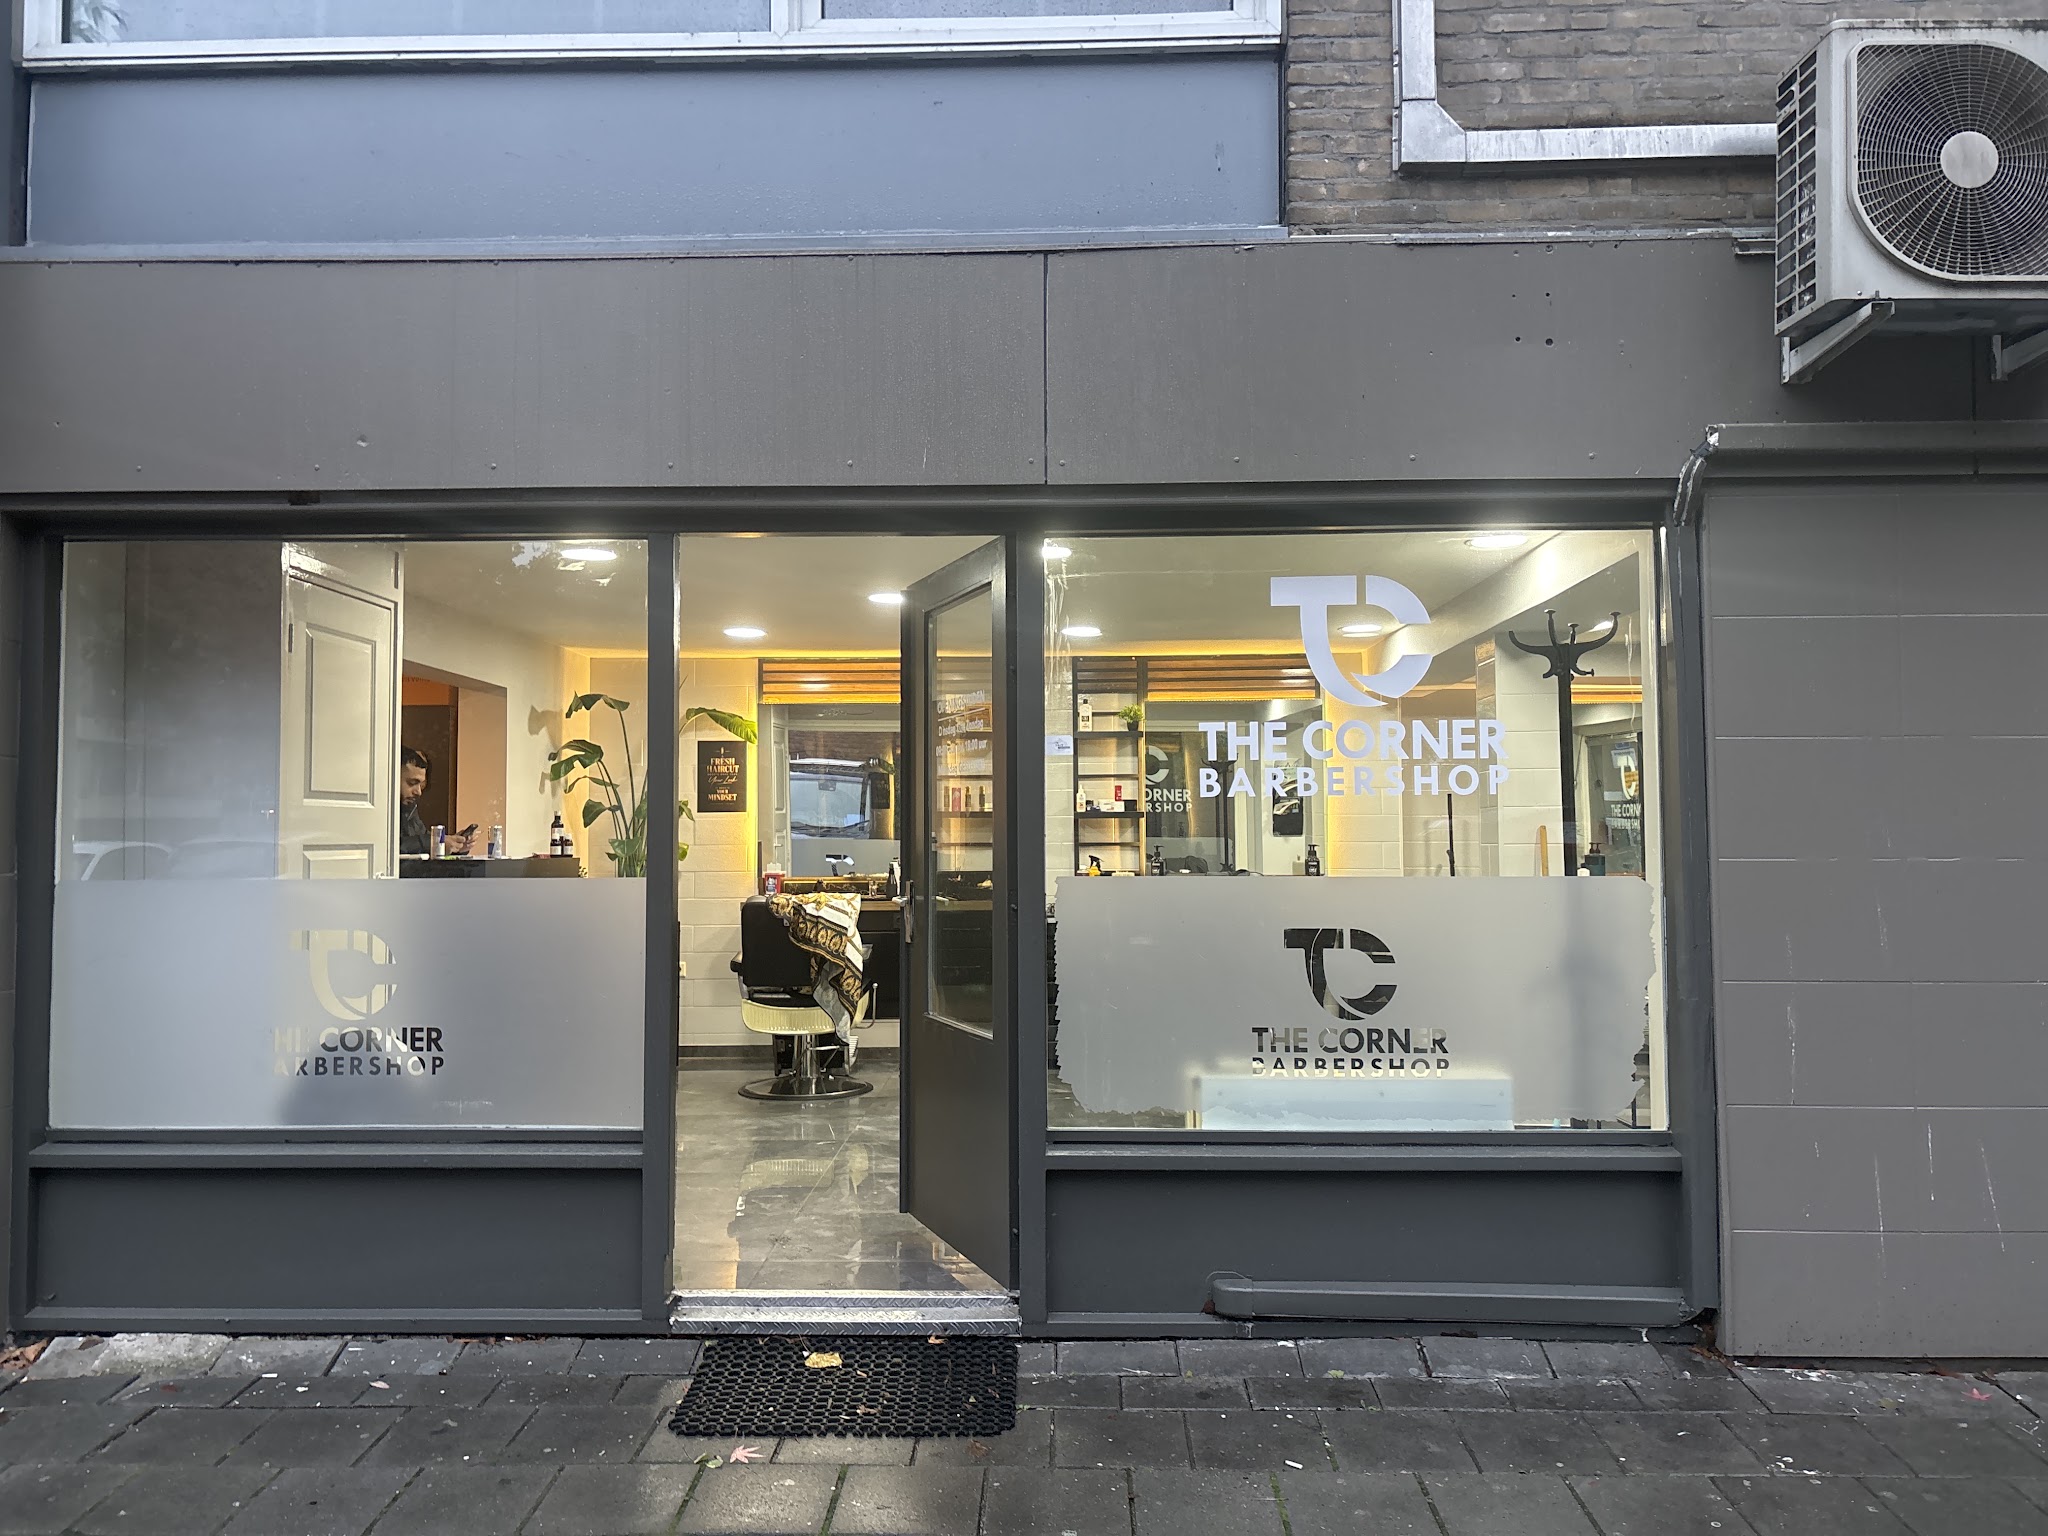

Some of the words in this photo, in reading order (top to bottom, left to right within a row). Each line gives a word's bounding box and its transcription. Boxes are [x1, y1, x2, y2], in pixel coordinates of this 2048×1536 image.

[1199, 721, 1288, 761] THE
[1302, 719, 1509, 760] CORNER
[706, 765, 740, 773] HAIRCUT
[710, 757, 735, 765] FRESH
[1200, 765, 1511, 798] BARBERSHOP
[707, 793, 738, 801] MINDSET
[1145, 788, 1192, 802] ORNER
[1146, 802, 1192, 813] RSHOP
[1622, 803, 1641, 817] CORN
[319, 1026, 444, 1052] CORNER
[1252, 1027, 1308, 1053] THE
[1318, 1027, 1449, 1054] CORNER
[272, 1056, 444, 1076] ARBERSHOP
[1251, 1057, 1450, 1078] BARBERSHOP
